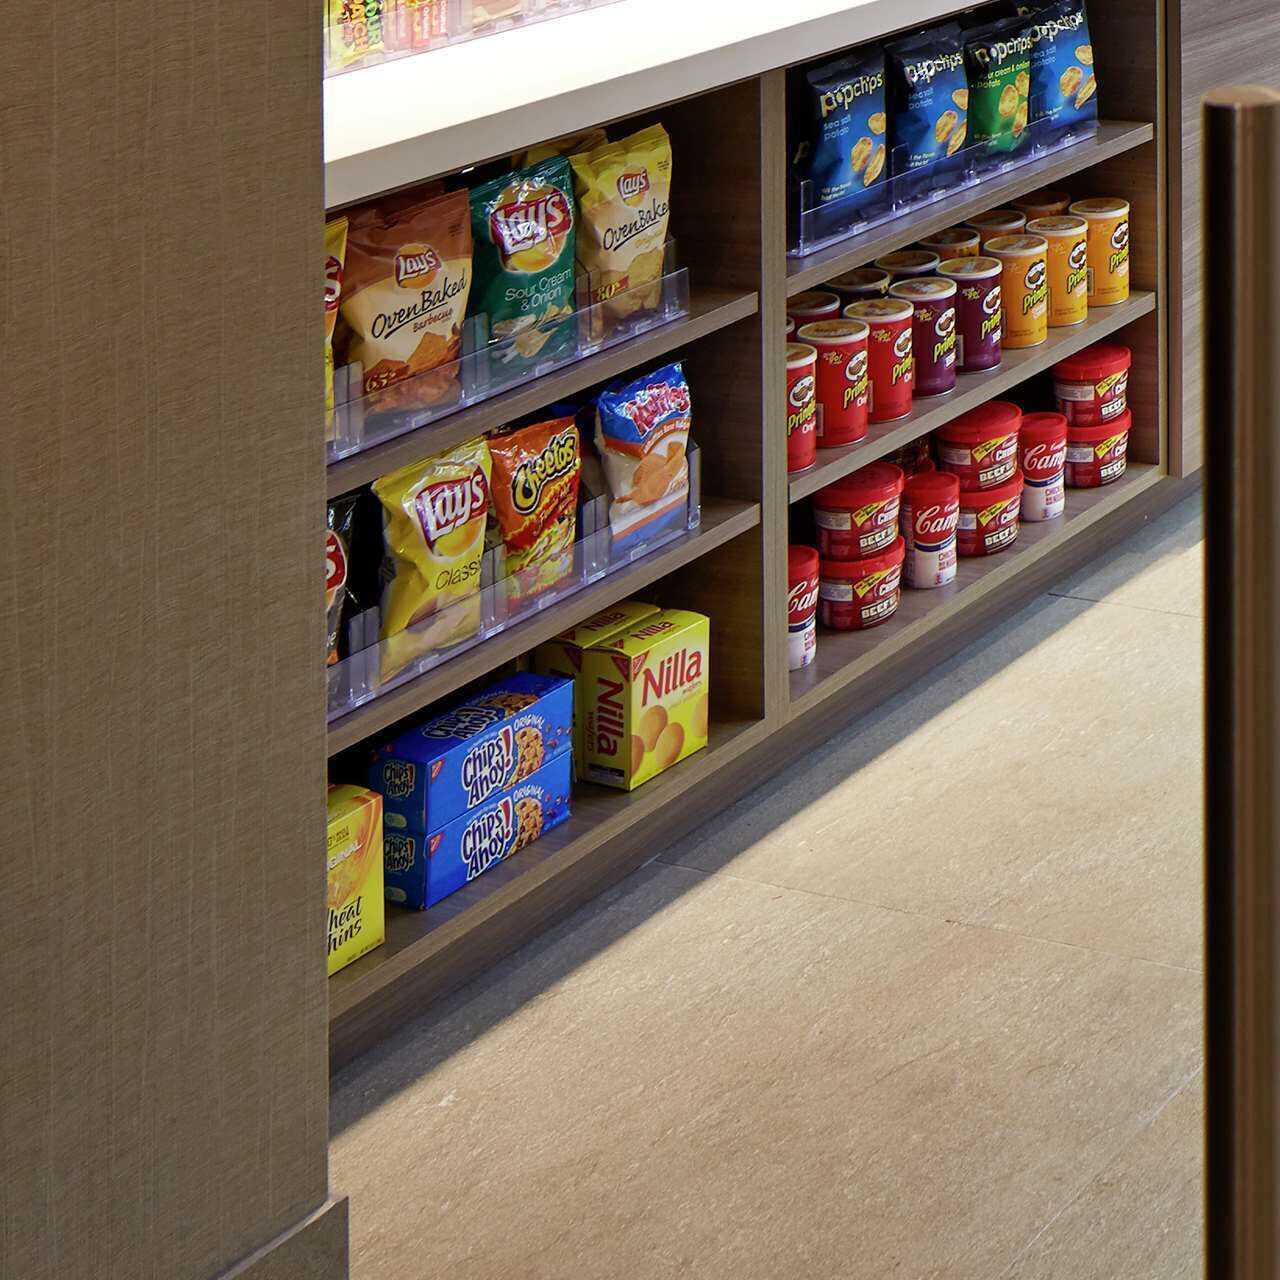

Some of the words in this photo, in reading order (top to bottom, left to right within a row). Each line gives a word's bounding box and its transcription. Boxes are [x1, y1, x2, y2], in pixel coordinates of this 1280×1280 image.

[820, 71, 884, 118] popchips
[619, 168, 649, 199] Lay's
[602, 222, 639, 251] Oven
[638, 199, 669, 228] Bake
[397, 249, 437, 281] Lay's
[505, 282, 537, 302] Sour
[537, 268, 572, 291] Cream
[371, 305, 420, 340] Oven
[419, 275, 468, 315] Baked
[412, 307, 454, 334] Barbecue
[521, 299, 529, 311] &
[531, 285, 563, 307] Onion
[932, 328, 957, 364] Pring
[626, 381, 692, 439] Ruffles
[512, 433, 577, 513] Cheetos
[415, 470, 485, 543] Lay's
[435, 552, 482, 592] Classi
[581, 609, 625, 632] Nilla
[631, 619, 674, 641] Nilla
[641, 647, 703, 708] Nilla
[513, 714, 545, 732] ORIGINAL
[596, 677, 625, 757] Nilla
[462, 734, 504, 789] Chips
[467, 726, 513, 808] Ahoy!
[512, 786, 545, 804] ORIGINAL
[461, 805, 504, 861] Chips
[466, 796, 513, 880] Ahoy!
